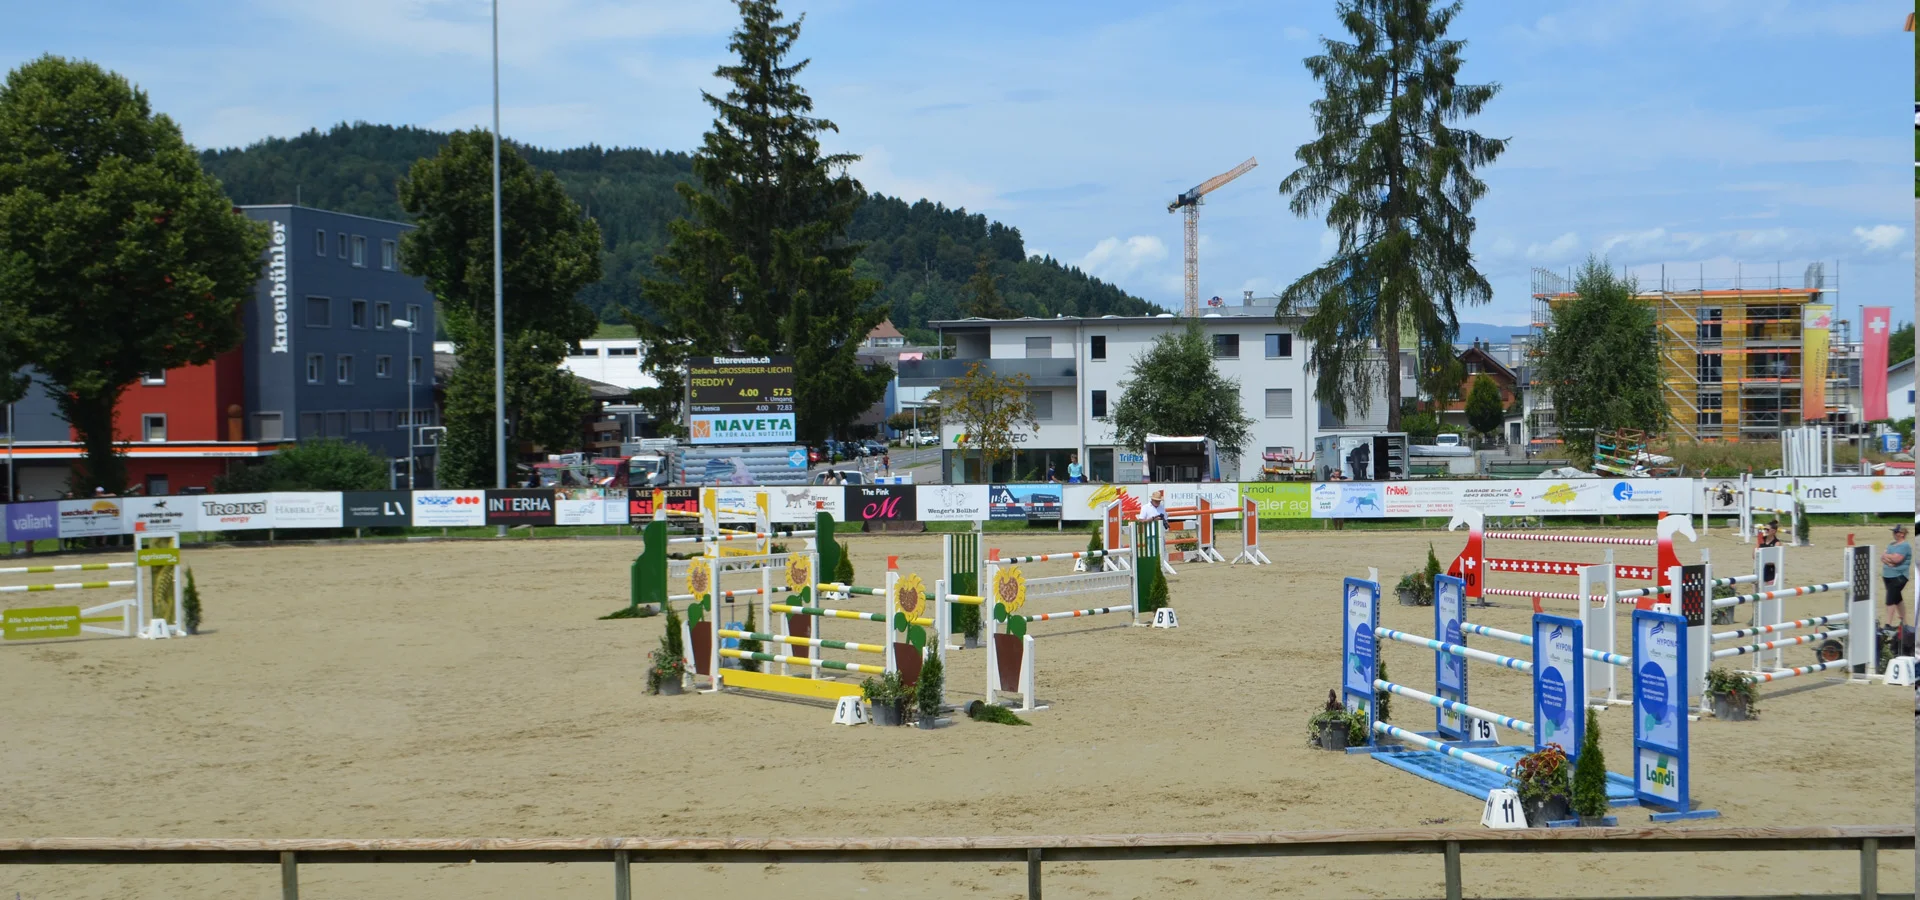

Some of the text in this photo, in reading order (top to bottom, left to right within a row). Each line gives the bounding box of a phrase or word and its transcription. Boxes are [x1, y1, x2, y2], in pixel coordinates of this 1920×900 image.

[270, 221, 288, 353] kneubühler
[713, 356, 770, 364] Etterevents.ch
[691, 367, 717, 375] Stefanie
[691, 378, 734, 387] FREDDY V
[691, 388, 792, 398] 6 4.00 57.3
[715, 419, 792, 431] NAVETA
[861, 488, 890, 496] The Pink
[489, 498, 551, 511] INTERHA
[862, 496, 902, 519] M
[1257, 498, 1309, 513] aler ag
[12, 513, 53, 530] valiant
[220, 515, 251, 523] energy
[140, 553, 173, 562] agrisano
[23, 615, 76, 623] Versicherungen
[1158, 611, 1164, 624] B
[1169, 611, 1175, 624] B
[158, 624, 162, 635] 1
[1556, 642, 1572, 652] HYPON
[1892, 664, 1899, 679] 9
[840, 701, 846, 719] 6
[855, 701, 862, 719] 6
[1478, 720, 1491, 739] 15
[1646, 763, 1675, 788] Landi
[1502, 799, 1515, 823] 11
